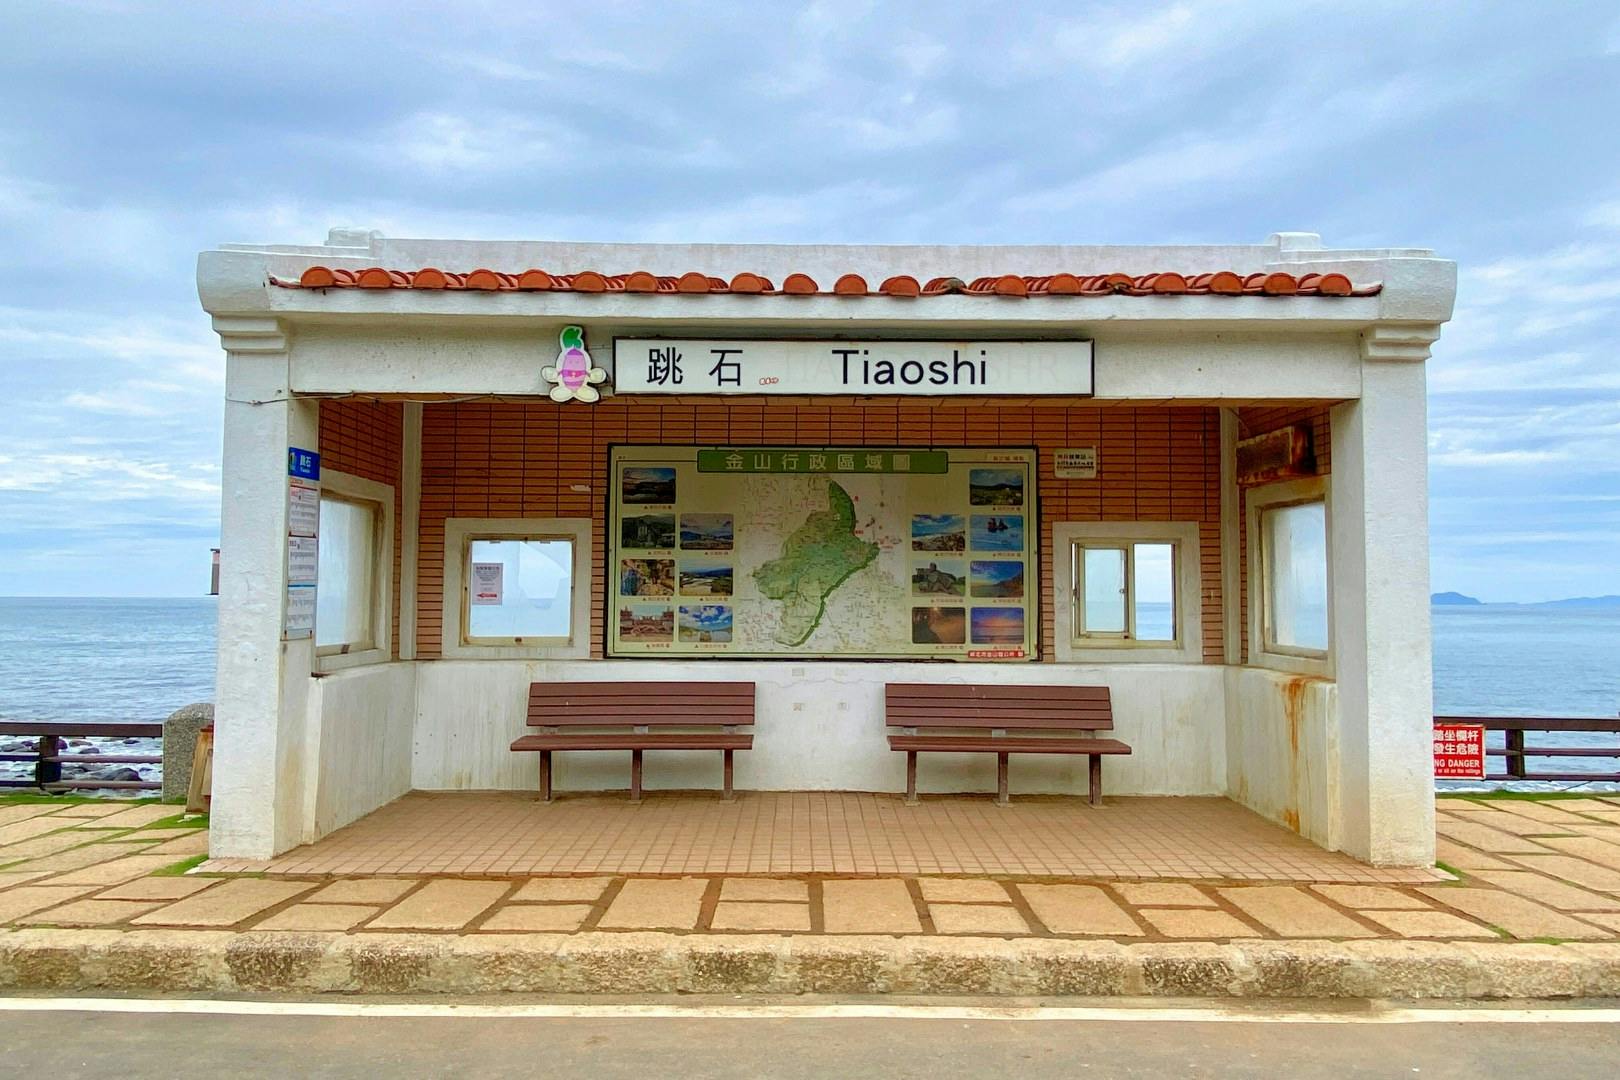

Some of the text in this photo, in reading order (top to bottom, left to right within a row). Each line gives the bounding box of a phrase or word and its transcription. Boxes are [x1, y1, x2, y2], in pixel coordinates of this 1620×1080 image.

[647, 347, 743, 386] 跳石
[832, 350, 986, 384] Tiaoshi
[1448, 759, 1480, 768] DANGER
